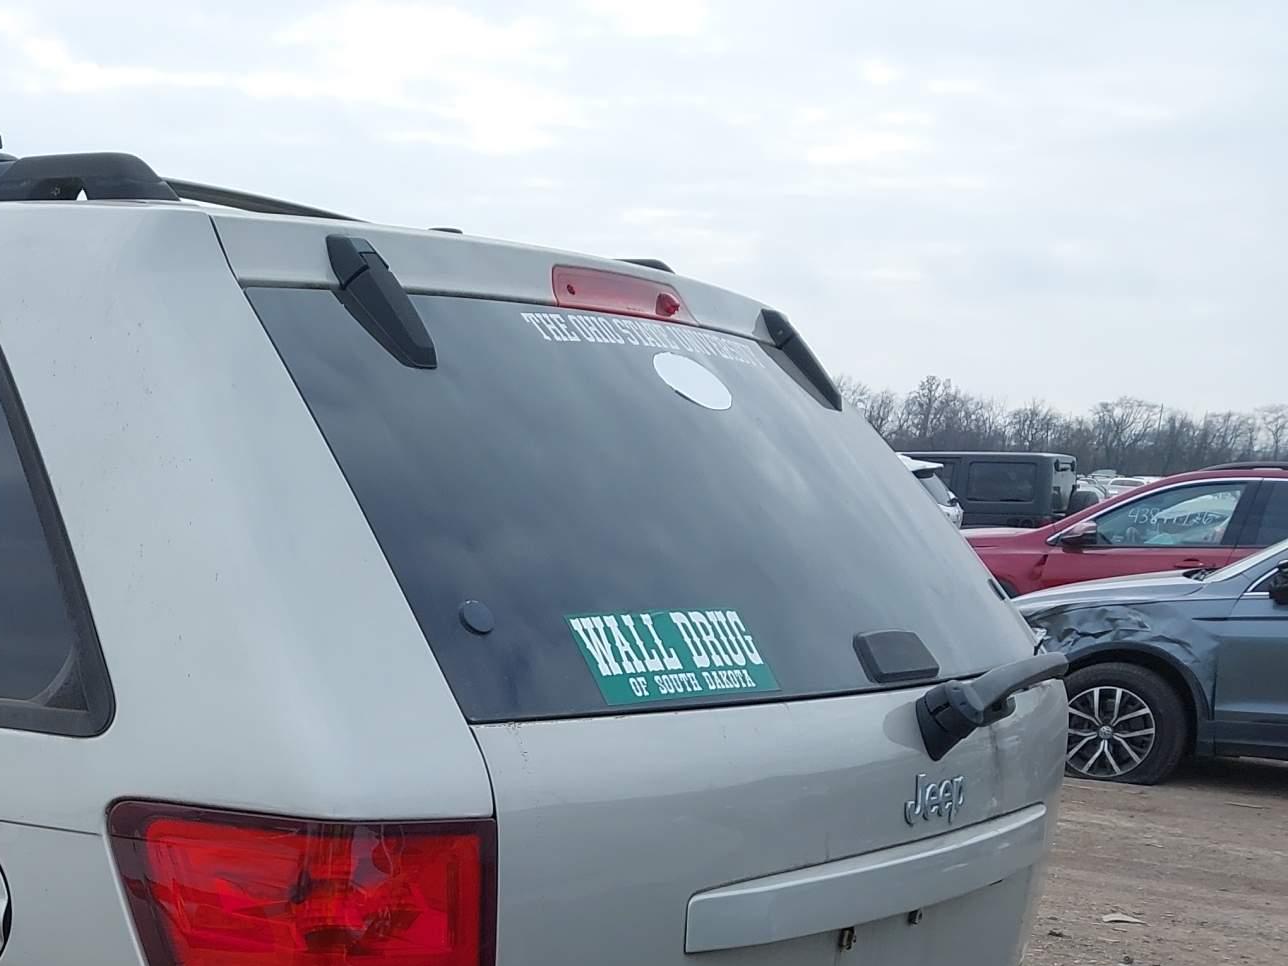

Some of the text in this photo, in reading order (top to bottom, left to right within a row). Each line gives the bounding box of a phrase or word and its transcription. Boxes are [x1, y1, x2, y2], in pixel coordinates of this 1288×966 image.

[520, 312, 582, 342] THE
[567, 314, 625, 345] OHIO
[569, 610, 765, 677] WALL DRUG
[628, 668, 757, 697] OF SOUTH DAKOTA
[903, 772, 965, 827] Jeep
